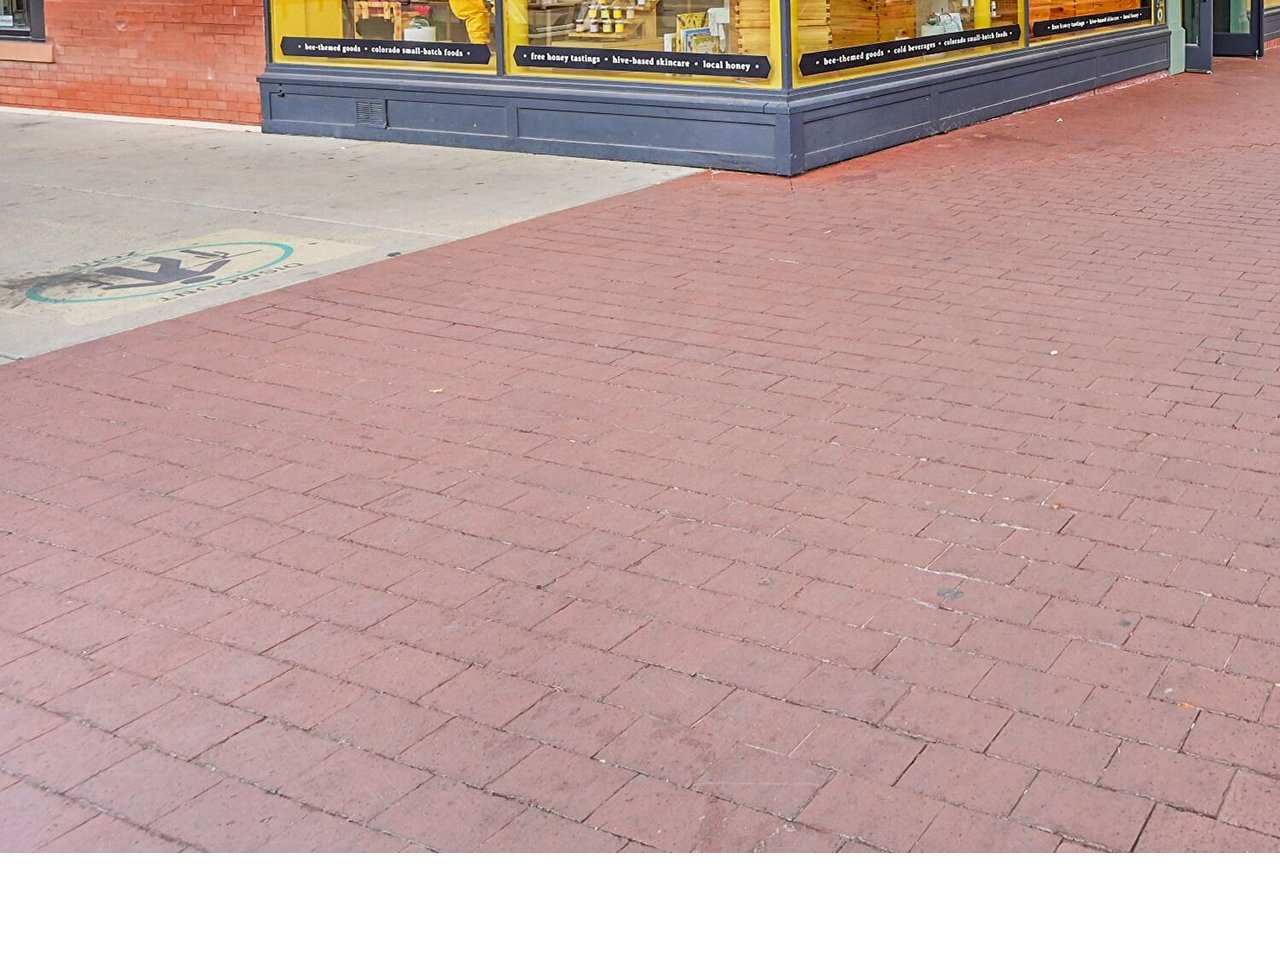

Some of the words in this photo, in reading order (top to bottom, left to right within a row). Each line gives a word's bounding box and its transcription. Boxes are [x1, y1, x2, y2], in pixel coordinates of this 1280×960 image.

[304, 43, 341, 52] bee-themed
[342, 44, 361, 53] goods
[371, 46, 401, 54] colorado
[402, 47, 442, 56] small-batch
[443, 48, 464, 57] foods
[893, 44, 907, 54] cold
[908, 42, 936, 53] beverages
[530, 52, 545, 61] free
[547, 52, 569, 63] honey
[570, 54, 600, 64] tastings
[612, 55, 654, 66] hive-based
[656, 57, 690, 67] skincare
[823, 51, 864, 65] bee-themed
[865, 49, 884, 60] goods
[703, 59, 723, 69] local
[725, 61, 751, 71] honey
[157, 262, 304, 303] DISMOUNT
